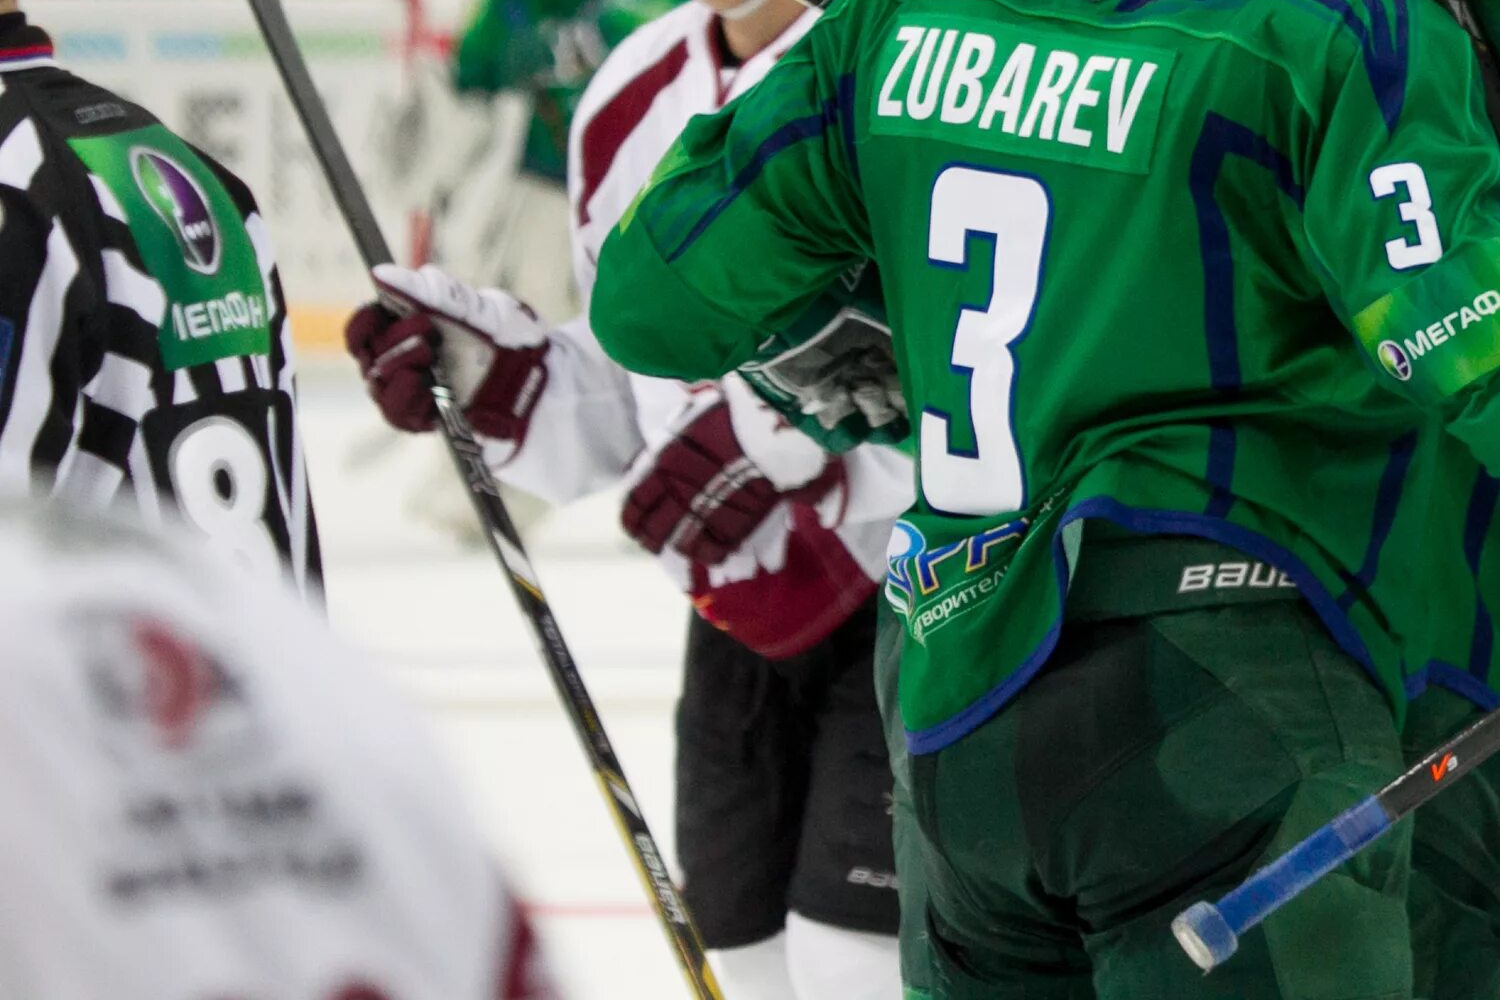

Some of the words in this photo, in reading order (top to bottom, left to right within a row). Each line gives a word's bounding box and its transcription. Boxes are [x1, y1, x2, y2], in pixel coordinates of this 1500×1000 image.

[877, 25, 1159, 155] ZUBAREV
[1369, 162, 1443, 270] 3
[921, 166, 1050, 514] 3
[1177, 560, 1298, 593] BAU
